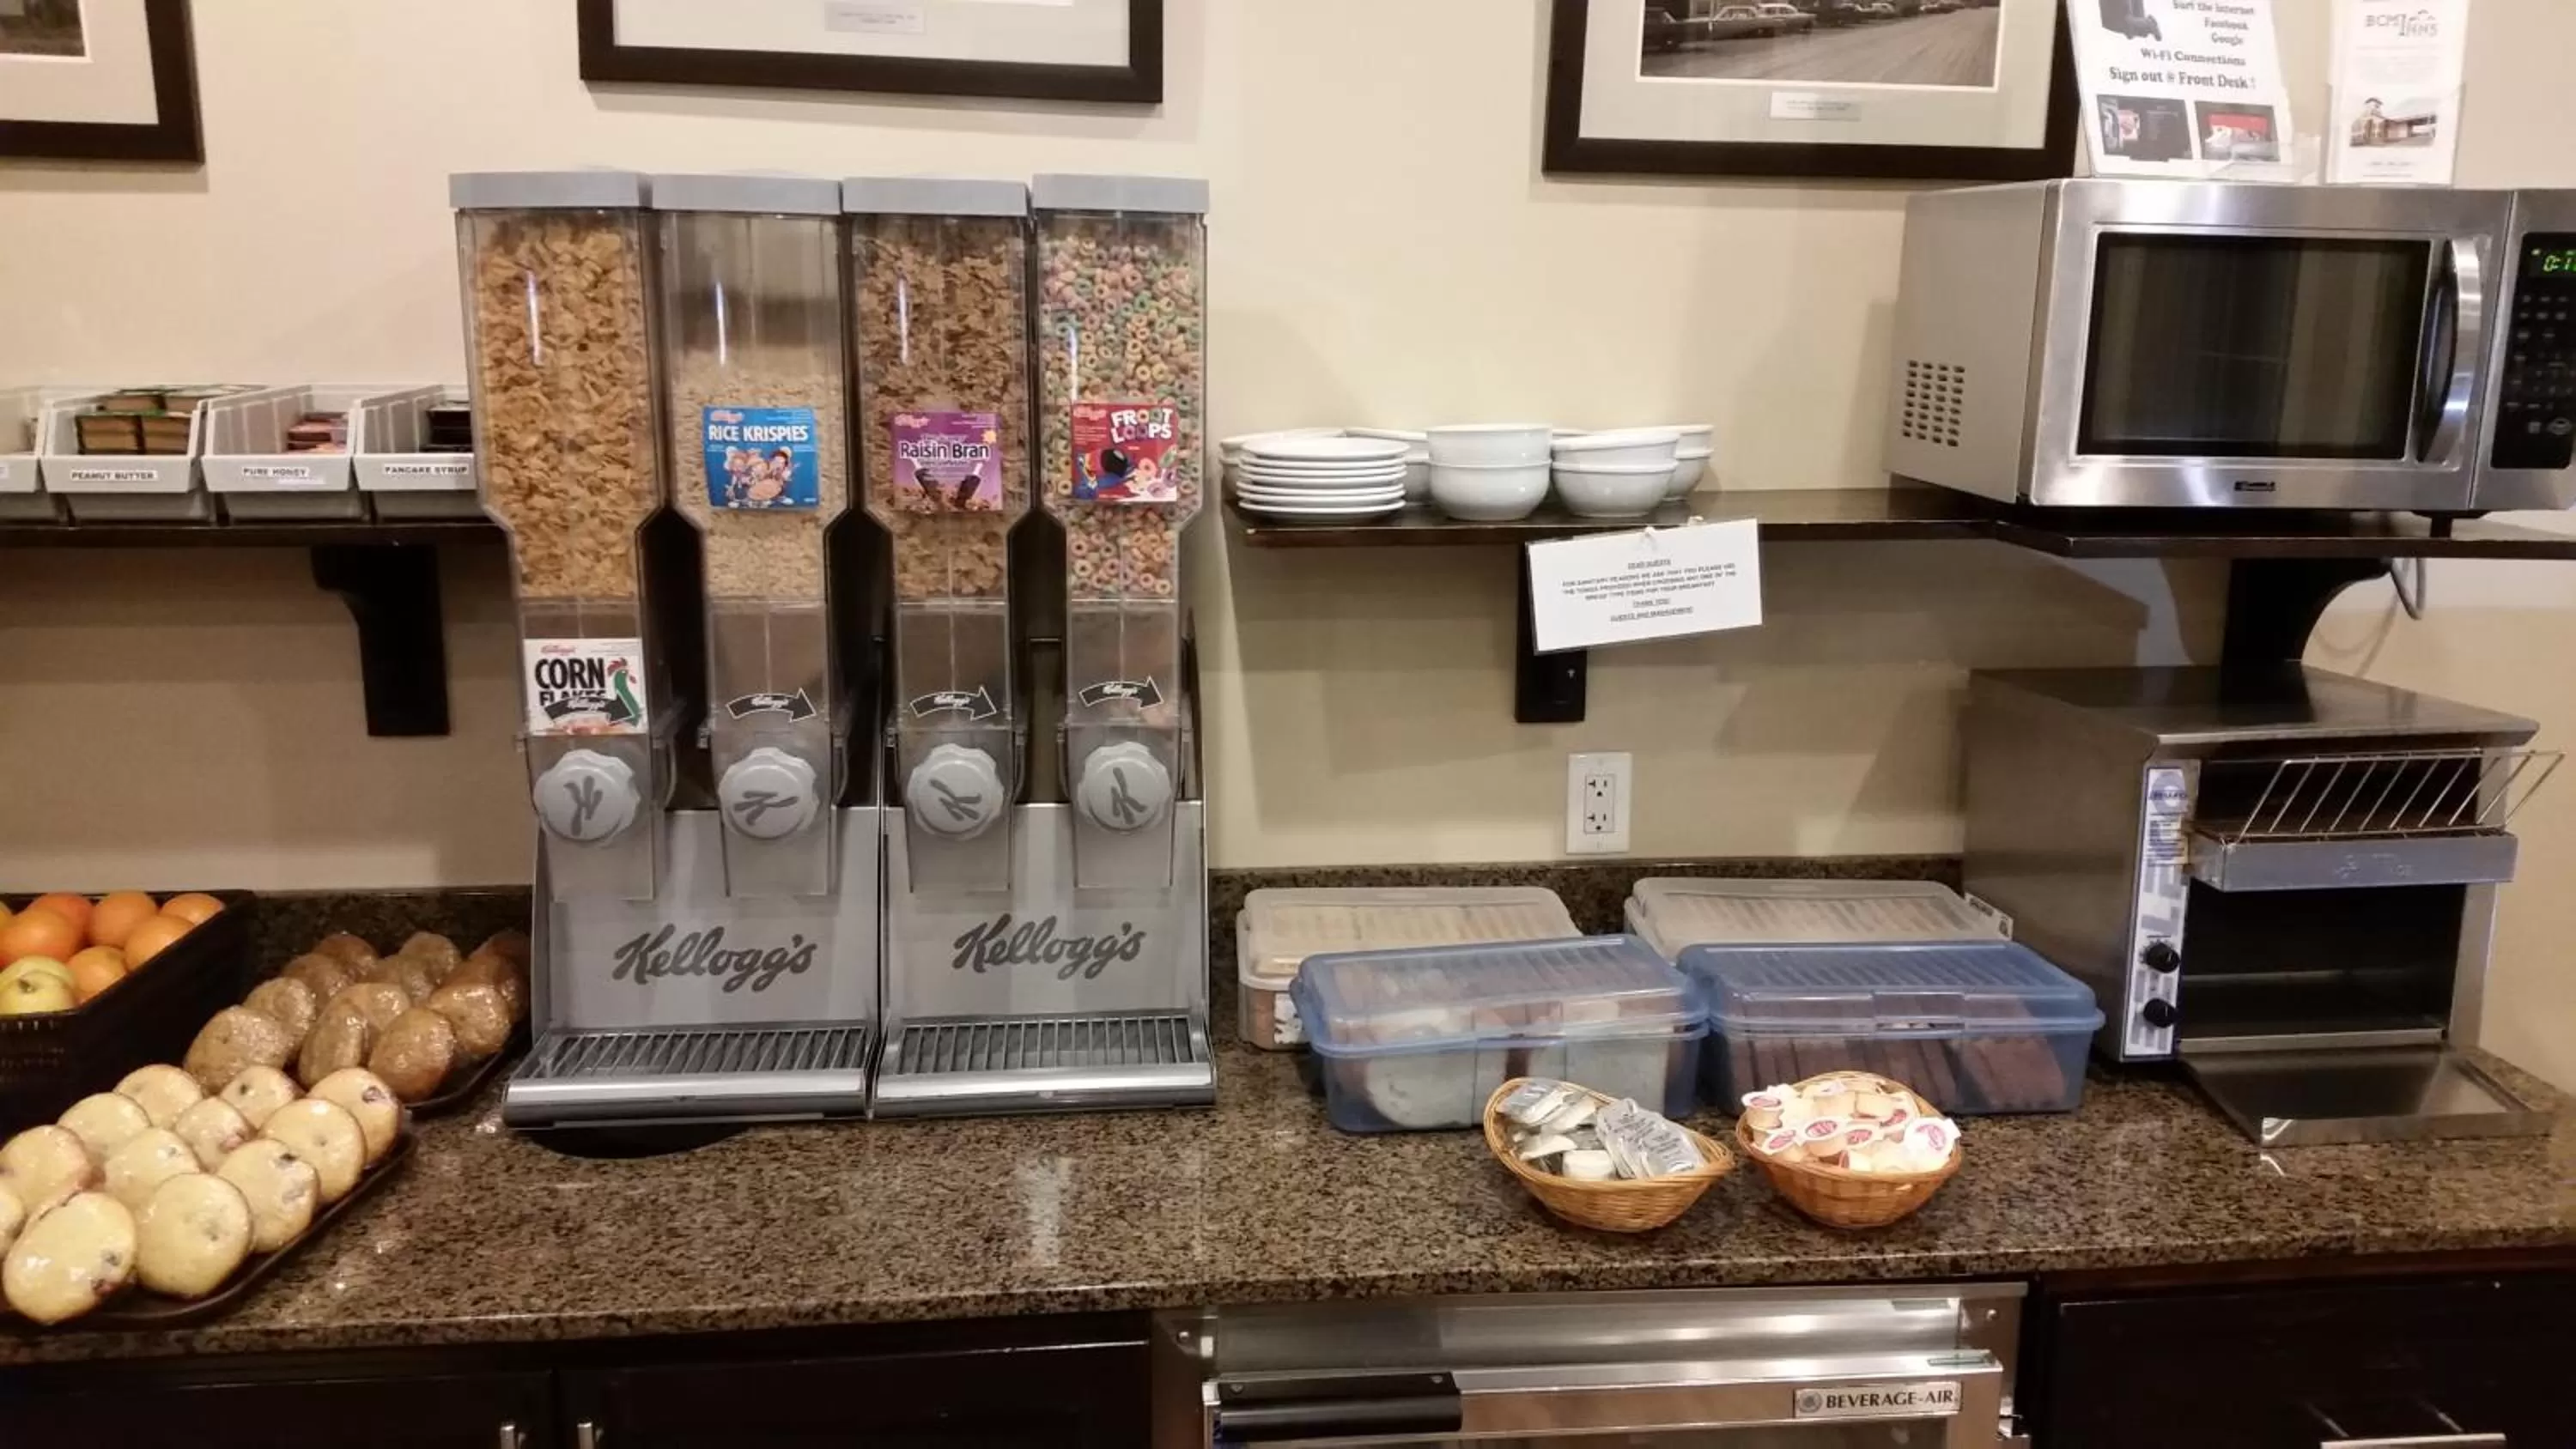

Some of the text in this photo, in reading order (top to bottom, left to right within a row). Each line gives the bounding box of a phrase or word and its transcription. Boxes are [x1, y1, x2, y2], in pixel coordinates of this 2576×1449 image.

[2174, 51, 2246, 66] Connections
[2109, 66, 2139, 84] Sign
[2141, 71, 2163, 83] out
[2178, 72, 2215, 88] Front
[1110, 408, 1174, 427] FROOT
[708, 425, 809, 442] RICE KRISPIES
[1110, 422, 1172, 443] LOOPS
[900, 441, 989, 459] Raisin Bran
[244, 468, 307, 477] PURE HONEY
[535, 657, 605, 688] CORN
[952, 912, 1146, 980] Kellogg's
[612, 924, 817, 993] Kellogg's
[1826, 1390, 1953, 1409] BEVERAGE-AIR
